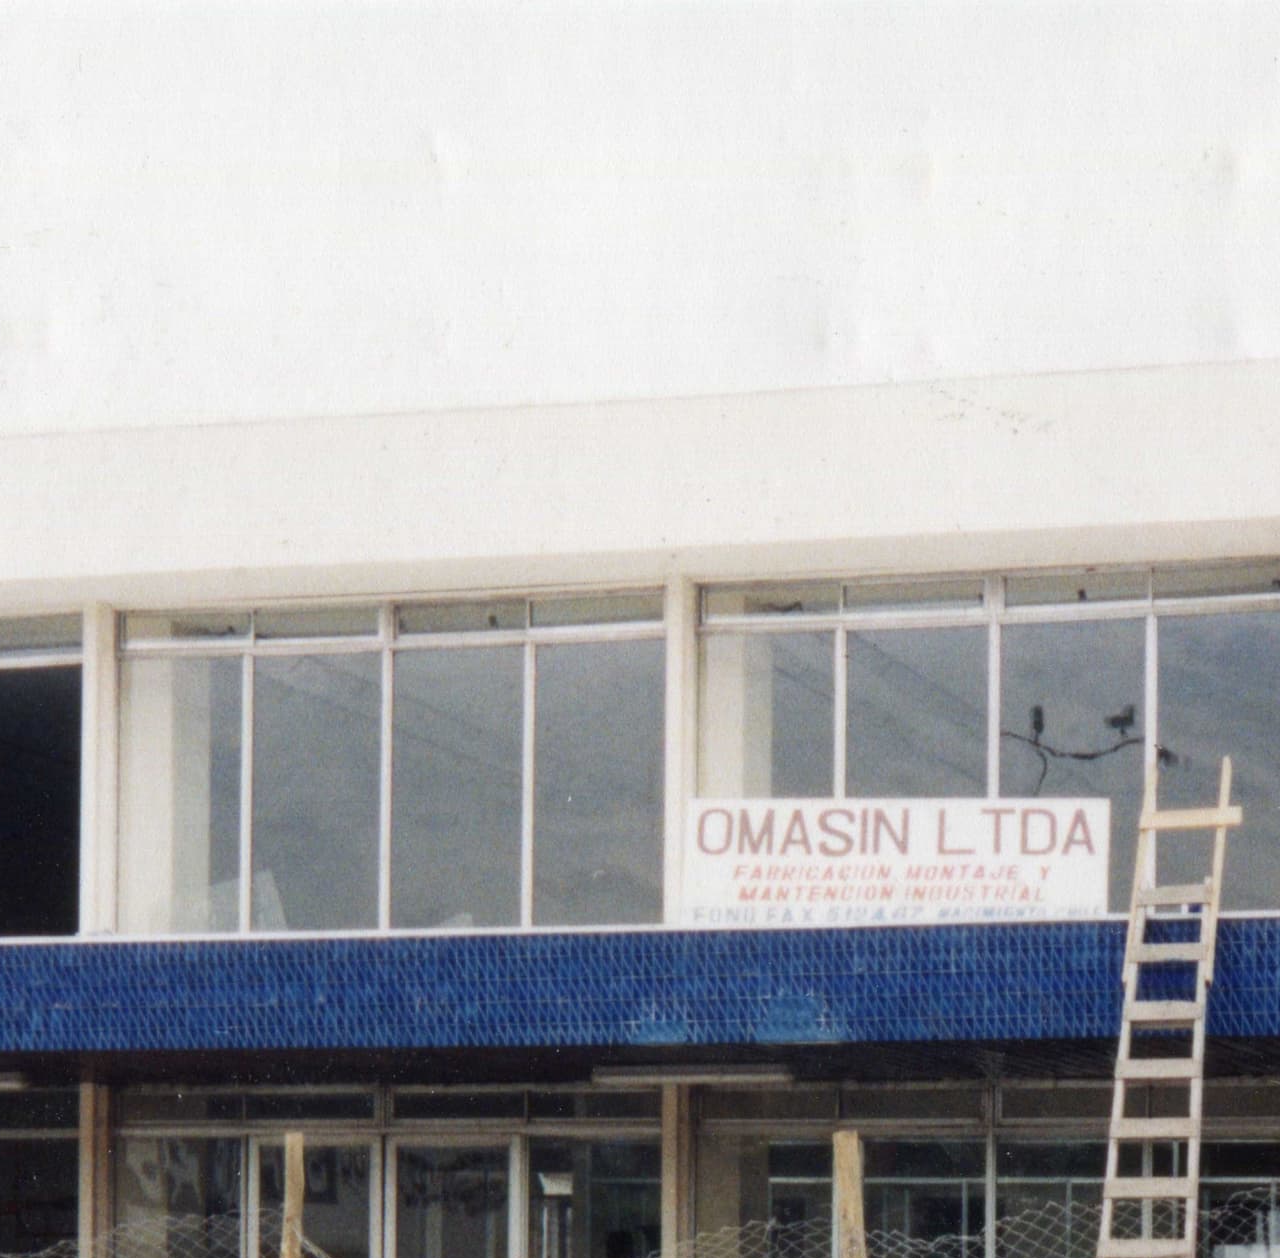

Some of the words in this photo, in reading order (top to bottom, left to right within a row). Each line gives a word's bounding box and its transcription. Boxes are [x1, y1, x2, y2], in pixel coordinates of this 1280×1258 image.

[696, 807, 910, 857] OMASIN
[936, 807, 1096, 856] LTDA
[732, 864, 892, 881] FABRICACION
[906, 863, 1019, 881] MONTAJE
[1038, 863, 1051, 880] Y
[737, 885, 894, 902] MANTENCION
[904, 884, 1046, 902] INDUSTRIAL
[765, 906, 814, 924] FAX
